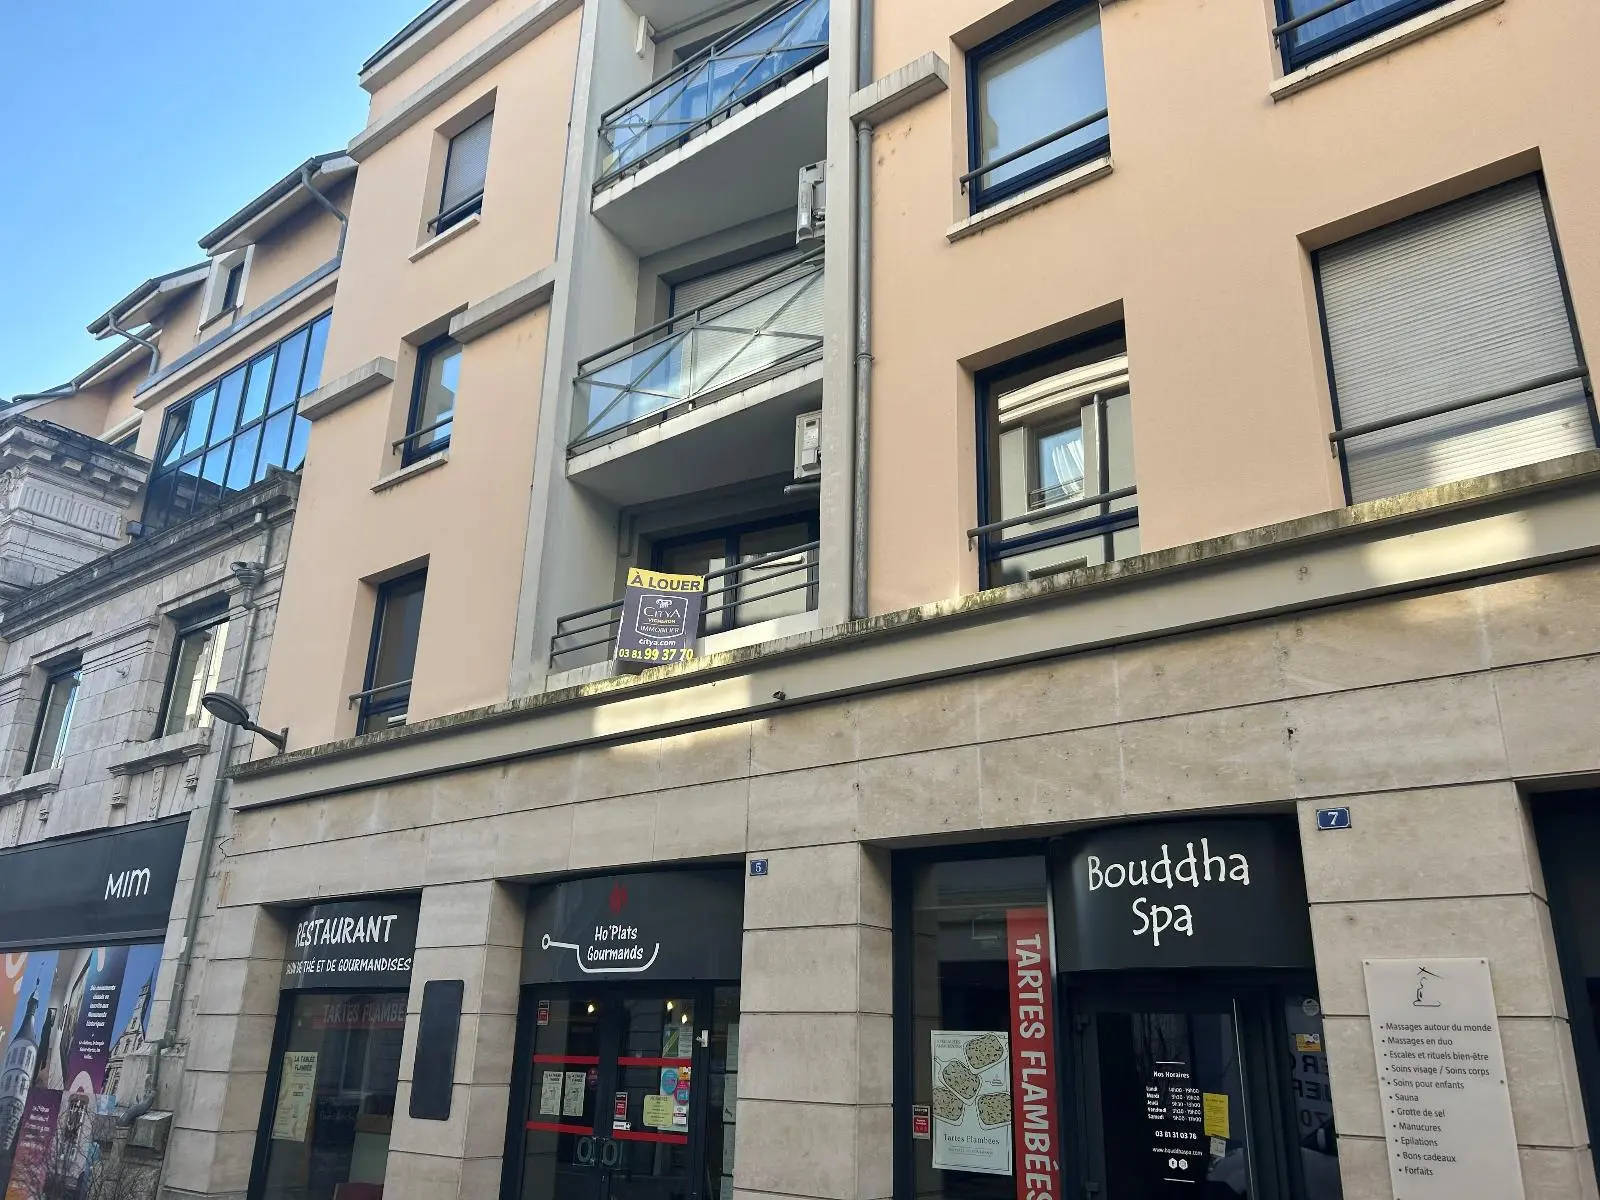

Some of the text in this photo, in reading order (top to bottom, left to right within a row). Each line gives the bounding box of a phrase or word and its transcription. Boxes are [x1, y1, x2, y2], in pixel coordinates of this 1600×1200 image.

[630, 572, 700, 591] À LOUER
[638, 638, 676, 646] citya.com
[619, 648, 694, 661] 03 81 99 37 70
[1328, 812, 1338, 825] 7
[756, 862, 762, 872] 5
[1088, 838, 1250, 890] Bouddha
[1132, 897, 1193, 946] Spa
[295, 915, 398, 948] RESTAURANT
[594, 925, 638, 942] Ho'Plats
[587, 945, 644, 962] Gourmands
[303, 957, 316, 973] THÉ
[316, 960, 326, 972] ET
[326, 960, 336, 972] DE
[338, 958, 412, 972] GOURMANDISES
[1014, 934, 1046, 1039] TARTES
[1386, 1023, 1422, 1032] Massages
[1388, 1036, 1424, 1046] Massages
[1453, 1052, 1489, 1060] bien-être
[1414, 1066, 1438, 1075] visage
[1394, 1079, 1414, 1087] Soins
[1435, 1081, 1464, 1089] enfants
[1394, 1093, 1418, 1102] Sauna
[1397, 1108, 1420, 1116] Grotte
[1434, 1110, 1445, 1118] sel
[1399, 1122, 1442, 1132] Manucures
[944, 1134, 964, 1142] Tartes
[1402, 1152, 1456, 1162] Bons cadeaux
[1404, 1166, 1434, 1176] Forfaits
